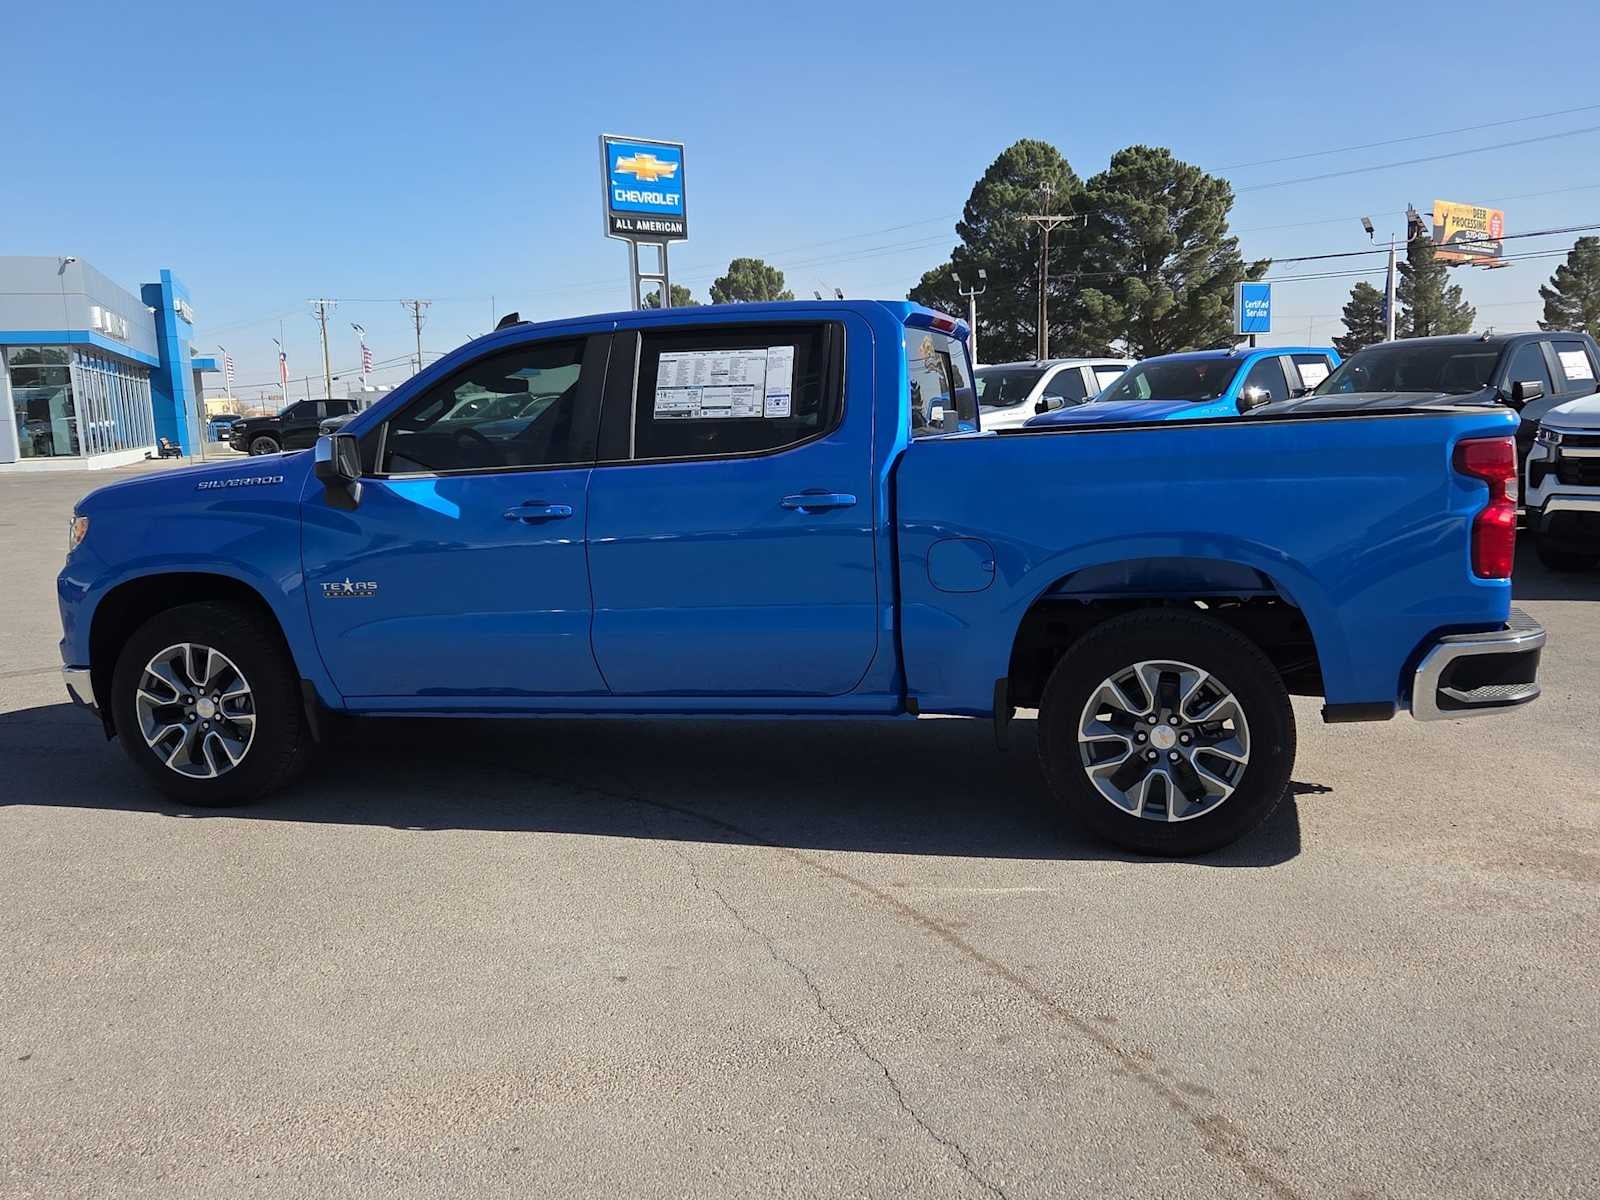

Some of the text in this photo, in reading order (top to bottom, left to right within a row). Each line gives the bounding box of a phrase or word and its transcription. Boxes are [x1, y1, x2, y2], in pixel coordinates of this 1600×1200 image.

[614, 189, 680, 206] CHEVROLET
[616, 219, 682, 233] ALL AMERICAN
[1452, 216, 1487, 230] PROCESSING
[1245, 300, 1269, 309] Certified
[1246, 309, 1267, 318] Service
[197, 475, 284, 490] SILVERADO
